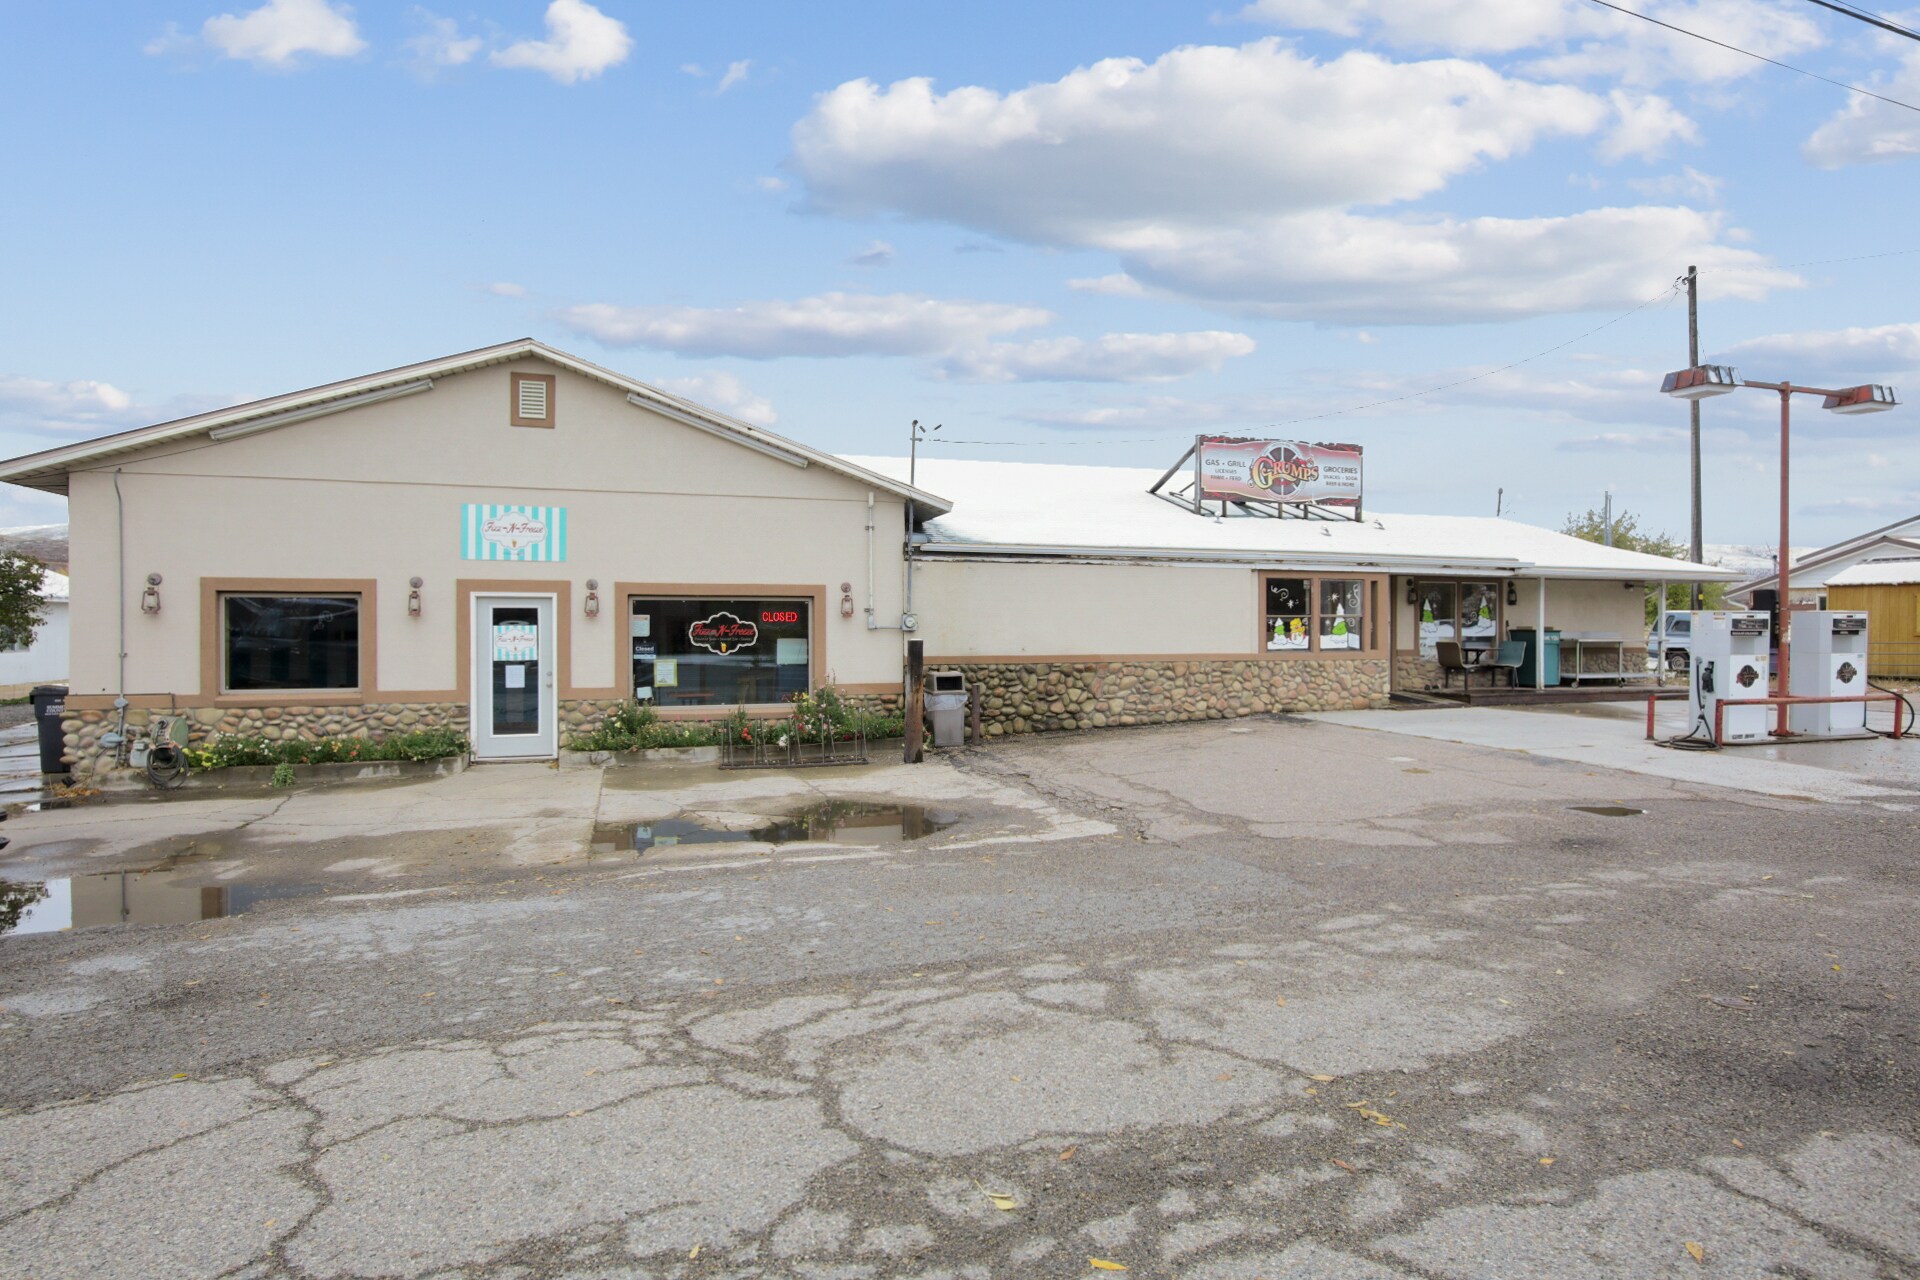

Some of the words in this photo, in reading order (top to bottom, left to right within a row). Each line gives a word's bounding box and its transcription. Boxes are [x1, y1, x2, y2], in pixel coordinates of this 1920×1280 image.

[1227, 460, 1246, 468] GRILL
[1323, 466, 1358, 474] GROCERIES
[762, 611, 798, 623] CLOSED
